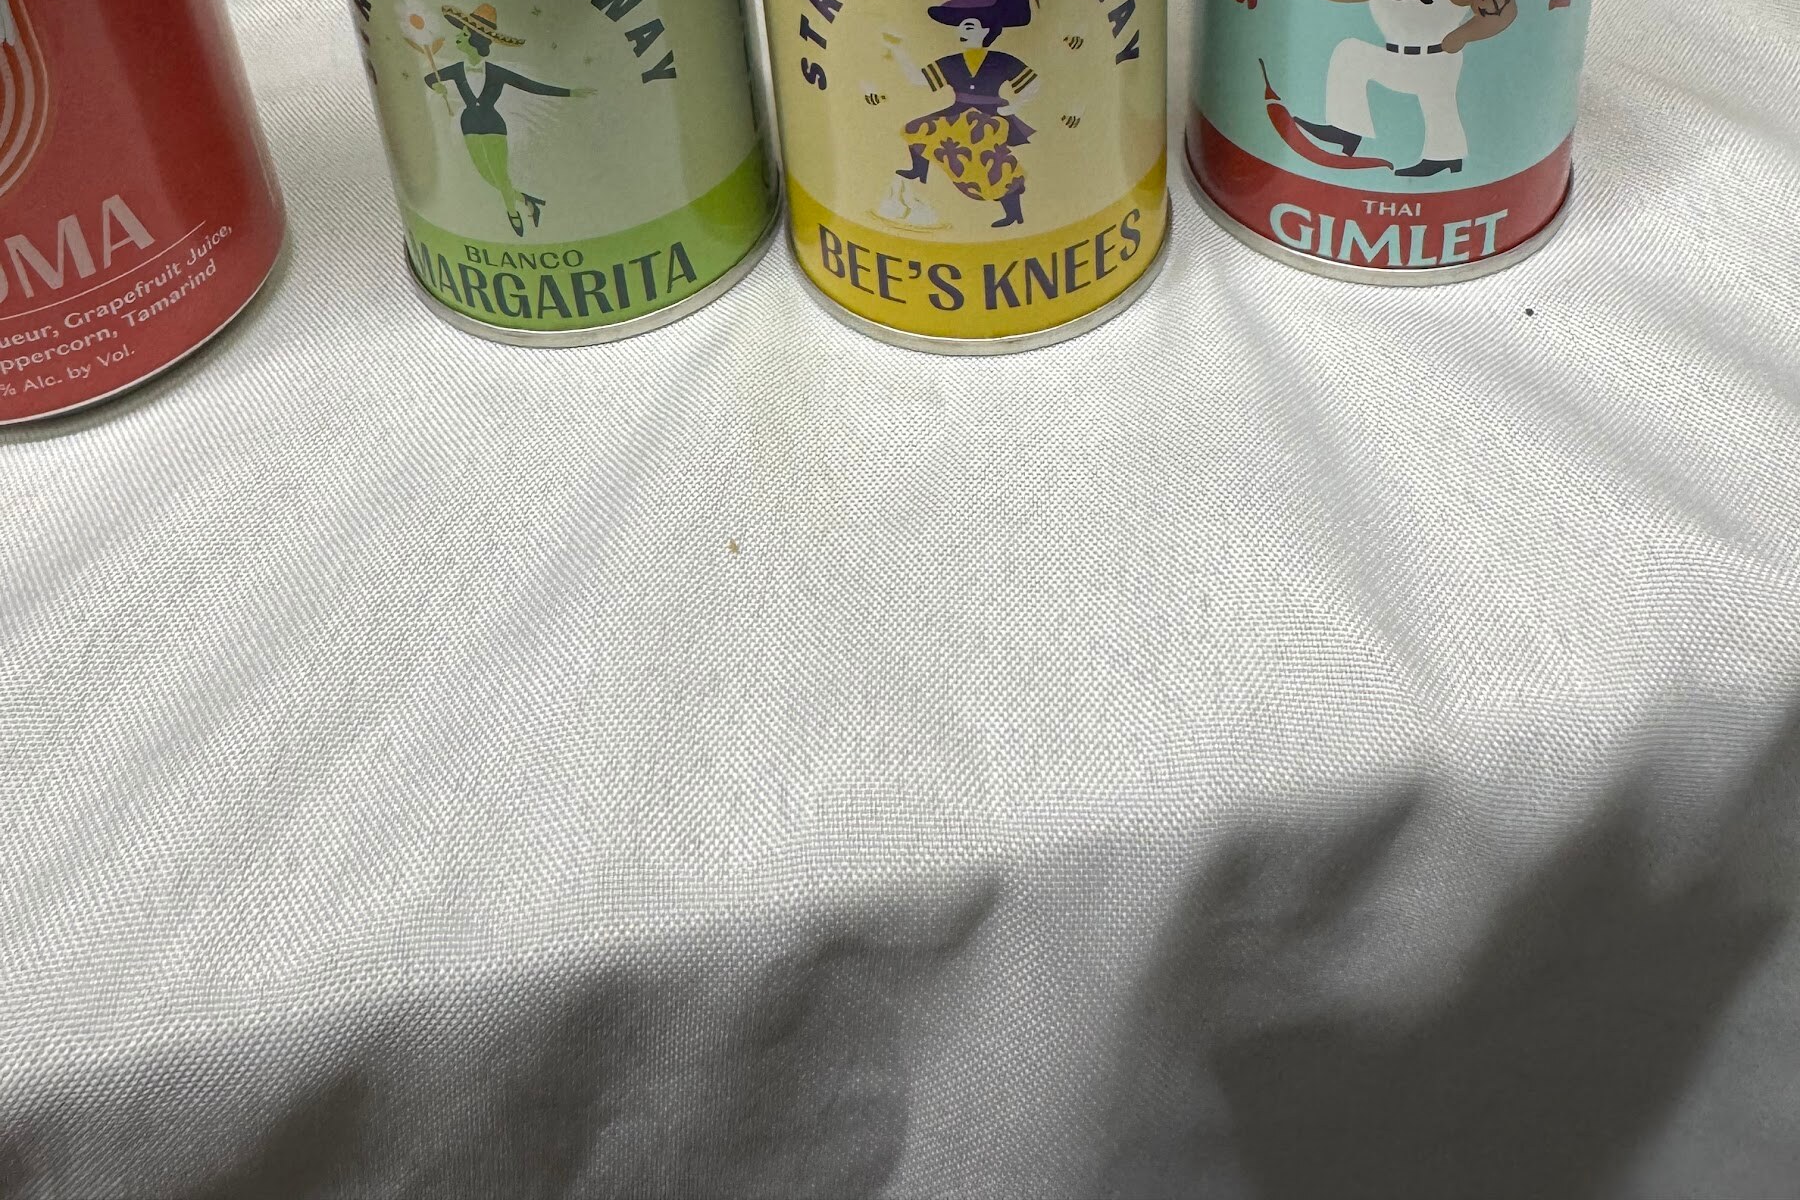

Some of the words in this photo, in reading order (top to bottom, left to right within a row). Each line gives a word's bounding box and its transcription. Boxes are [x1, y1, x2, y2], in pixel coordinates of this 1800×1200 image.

[1269, 203, 1508, 267] GIMLET
[1362, 200, 1421, 217] THAI
[64, 261, 182, 329] Grapefruit
[187, 225, 233, 266] Juice,
[464, 244, 584, 270] BLANCO
[818, 223, 965, 311] BEE'S
[983, 208, 1141, 311] KNEES
[121, 258, 217, 327] Tamarind
[23, 375, 63, 393] Alc.
[67, 363, 92, 380] by
[96, 344, 136, 367] Vol.
